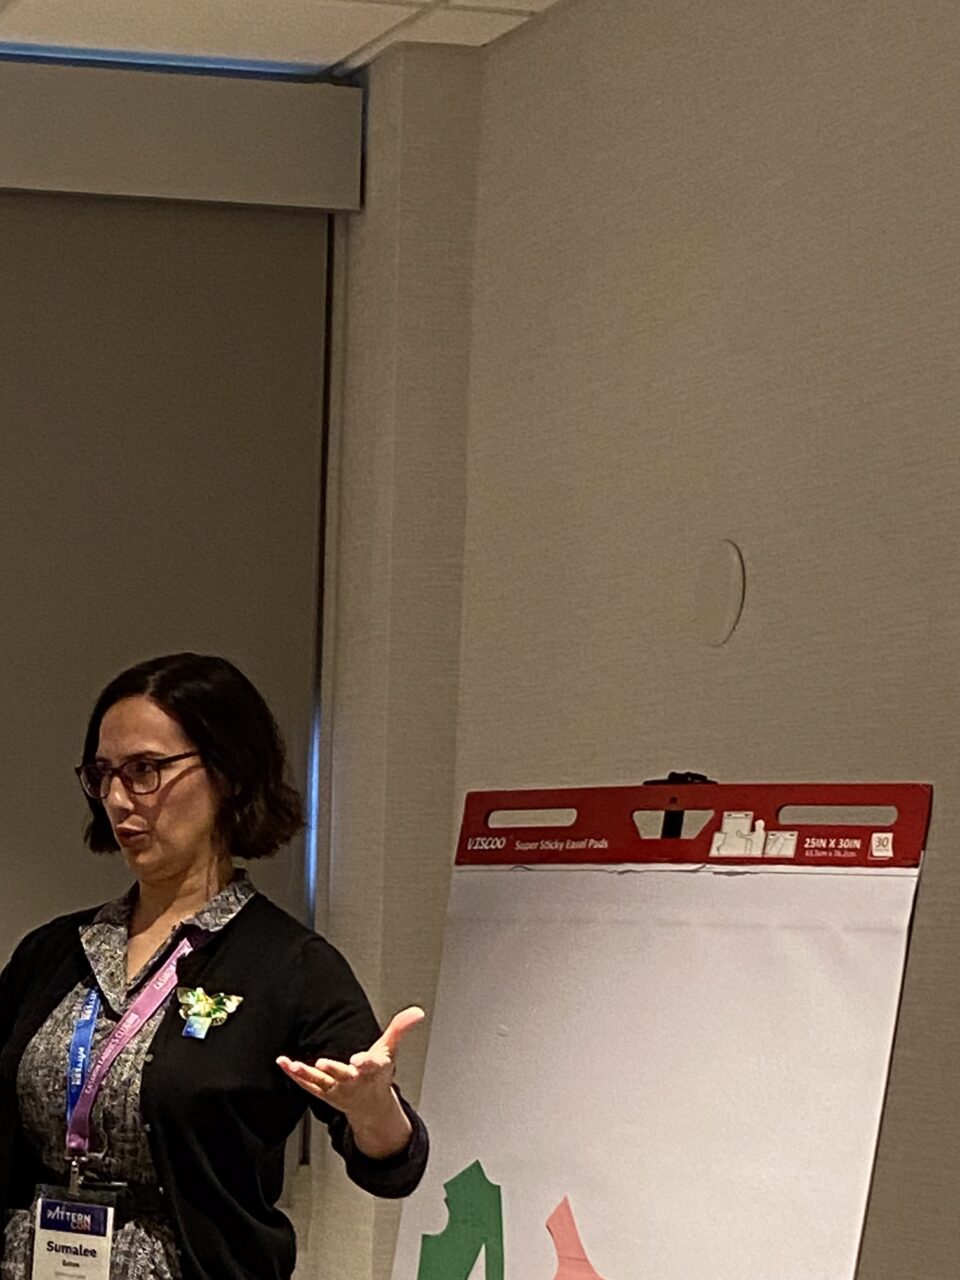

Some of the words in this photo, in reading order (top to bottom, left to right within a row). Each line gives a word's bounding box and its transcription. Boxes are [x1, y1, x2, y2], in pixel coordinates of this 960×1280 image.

[467, 837, 506, 850] VISCOO
[515, 840, 539, 851] Super
[539, 839, 565, 851] Sticky
[565, 838, 587, 849] Easel
[588, 838, 609, 849] Pads
[804, 838, 827, 848] 25IN
[838, 838, 861, 850] 30IN
[875, 836, 890, 848] 30
[46, 1205, 92, 1223] PATTERN
[46, 1240, 97, 1258] Sumalee
